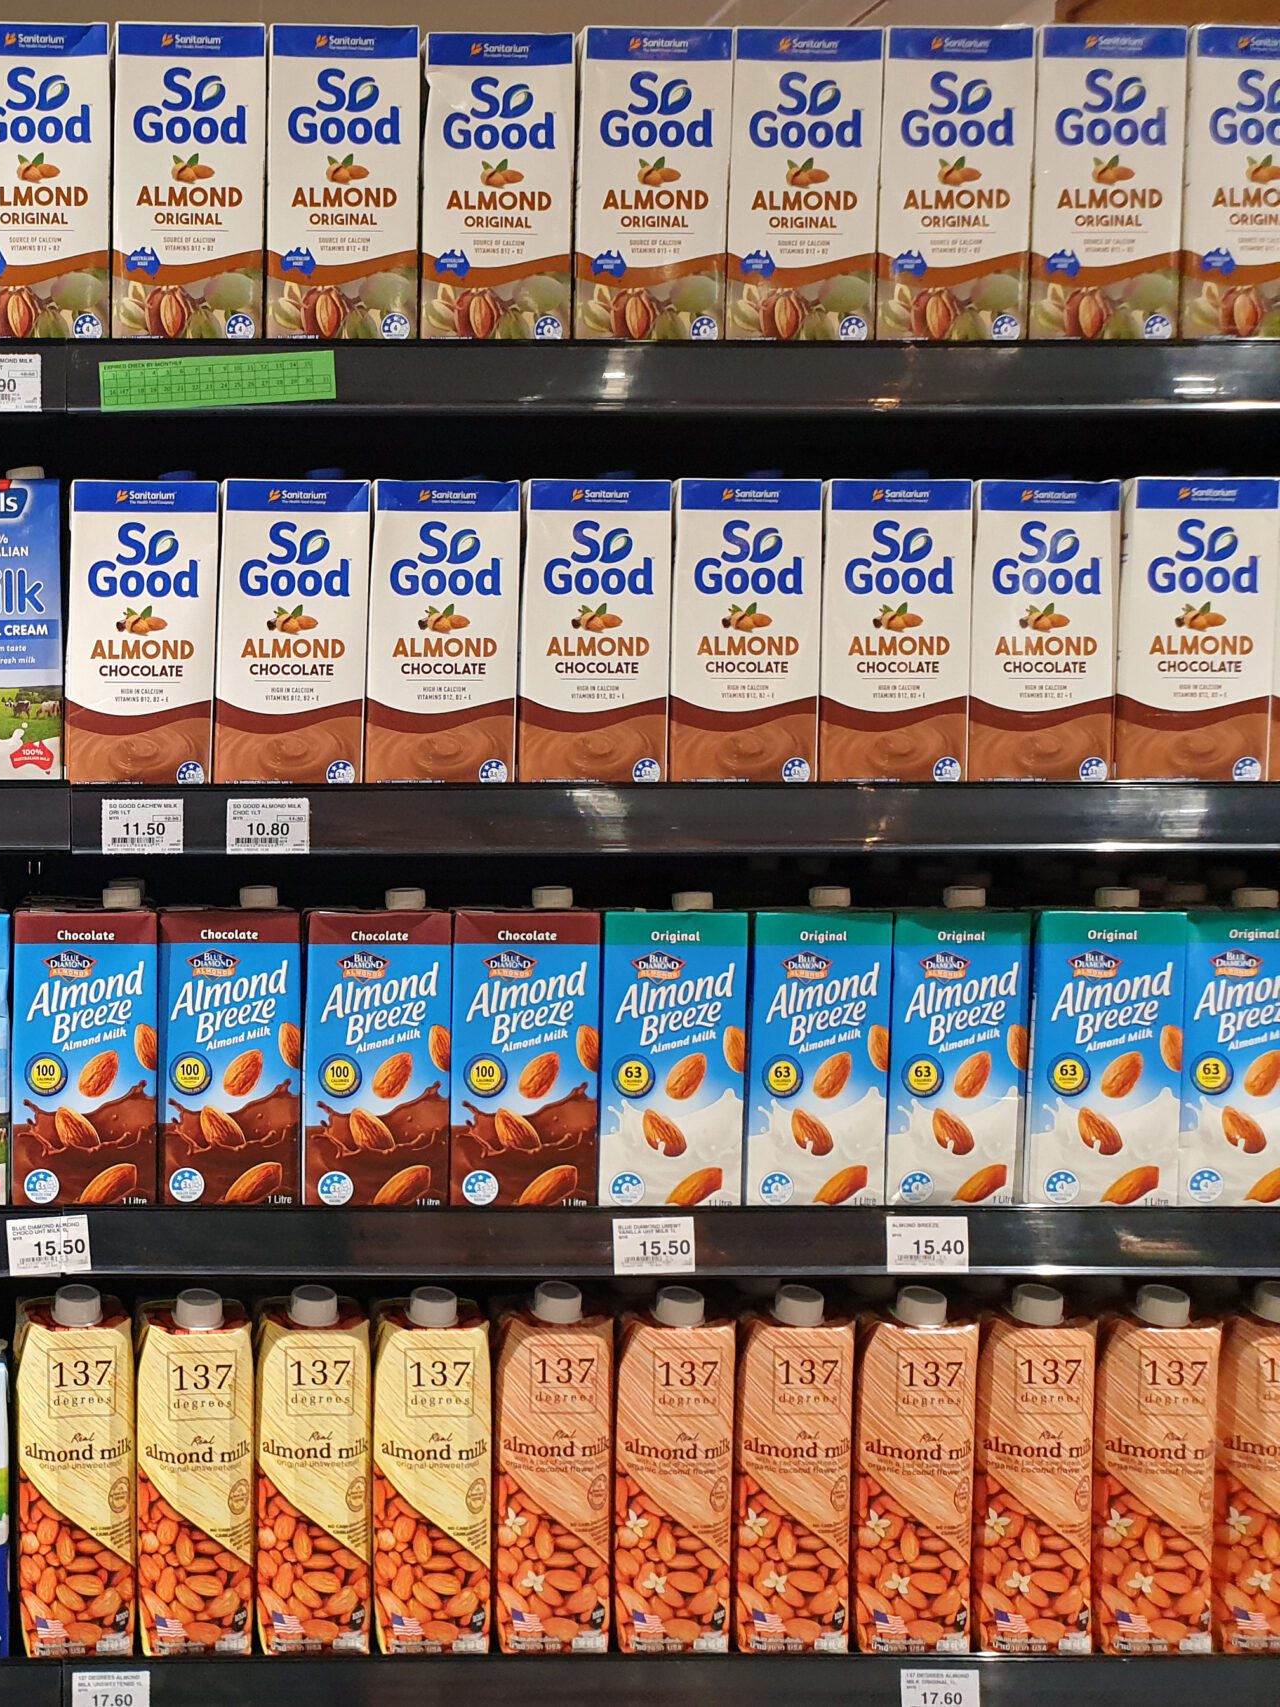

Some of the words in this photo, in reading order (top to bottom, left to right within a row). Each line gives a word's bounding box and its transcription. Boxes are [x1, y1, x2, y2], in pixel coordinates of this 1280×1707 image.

[1083, 69, 1146, 113] So
[1055, 106, 1167, 146] Good
[1057, 189, 1162, 209] ALMOND
[1075, 215, 1142, 227] ORIGINAL
[129, 490, 175, 500] Sanitarium
[116, 521, 179, 565] So
[1175, 519, 1238, 562] So
[88, 559, 199, 598] Good
[1148, 555, 1259, 594] Good
[4, 625, 48, 636] CREAM
[90, 640, 194, 660] ALMOND
[1149, 635, 1254, 655] ALMOND
[99, 665, 183, 677] CHOCOLATE
[1157, 661, 1242, 673] CHOCOLATE
[123, 823, 165, 836] 11.50
[247, 823, 290, 836] 10.80
[57, 930, 115, 941] Chocolate
[938, 931, 985, 943] Original
[50, 960, 90, 968] DIAMOND
[61, 954, 81, 962] BLUE
[26, 961, 145, 1022] Almond
[905, 962, 1019, 1023] Almond
[52, 999, 132, 1044] Breeze
[928, 1000, 1006, 1046] Breeze
[62, 1034, 100, 1052] Almond
[103, 1028, 127, 1041] Milk
[36, 1065, 55, 1076] 100
[914, 1066, 931, 1078] 63
[274, 1195, 292, 1204] Litre
[34, 1239, 85, 1257] 15.50
[639, 1240, 690, 1256] 15.50
[913, 1240, 964, 1255] 15.40
[52, 1360, 112, 1388] 137
[658, 1361, 719, 1386] 137
[1020, 1359, 1082, 1385] 137
[53, 1396, 112, 1406] degrees
[659, 1395, 717, 1406] degrees
[71, 1432, 95, 1444] Real
[25, 1443, 93, 1462] almond
[100, 1438, 132, 1461] milk
[625, 1438, 697, 1460] almond
[705, 1439, 730, 1459] milk
[92, 1694, 133, 1706] 17.60
[921, 1691, 962, 1705] 17.60
